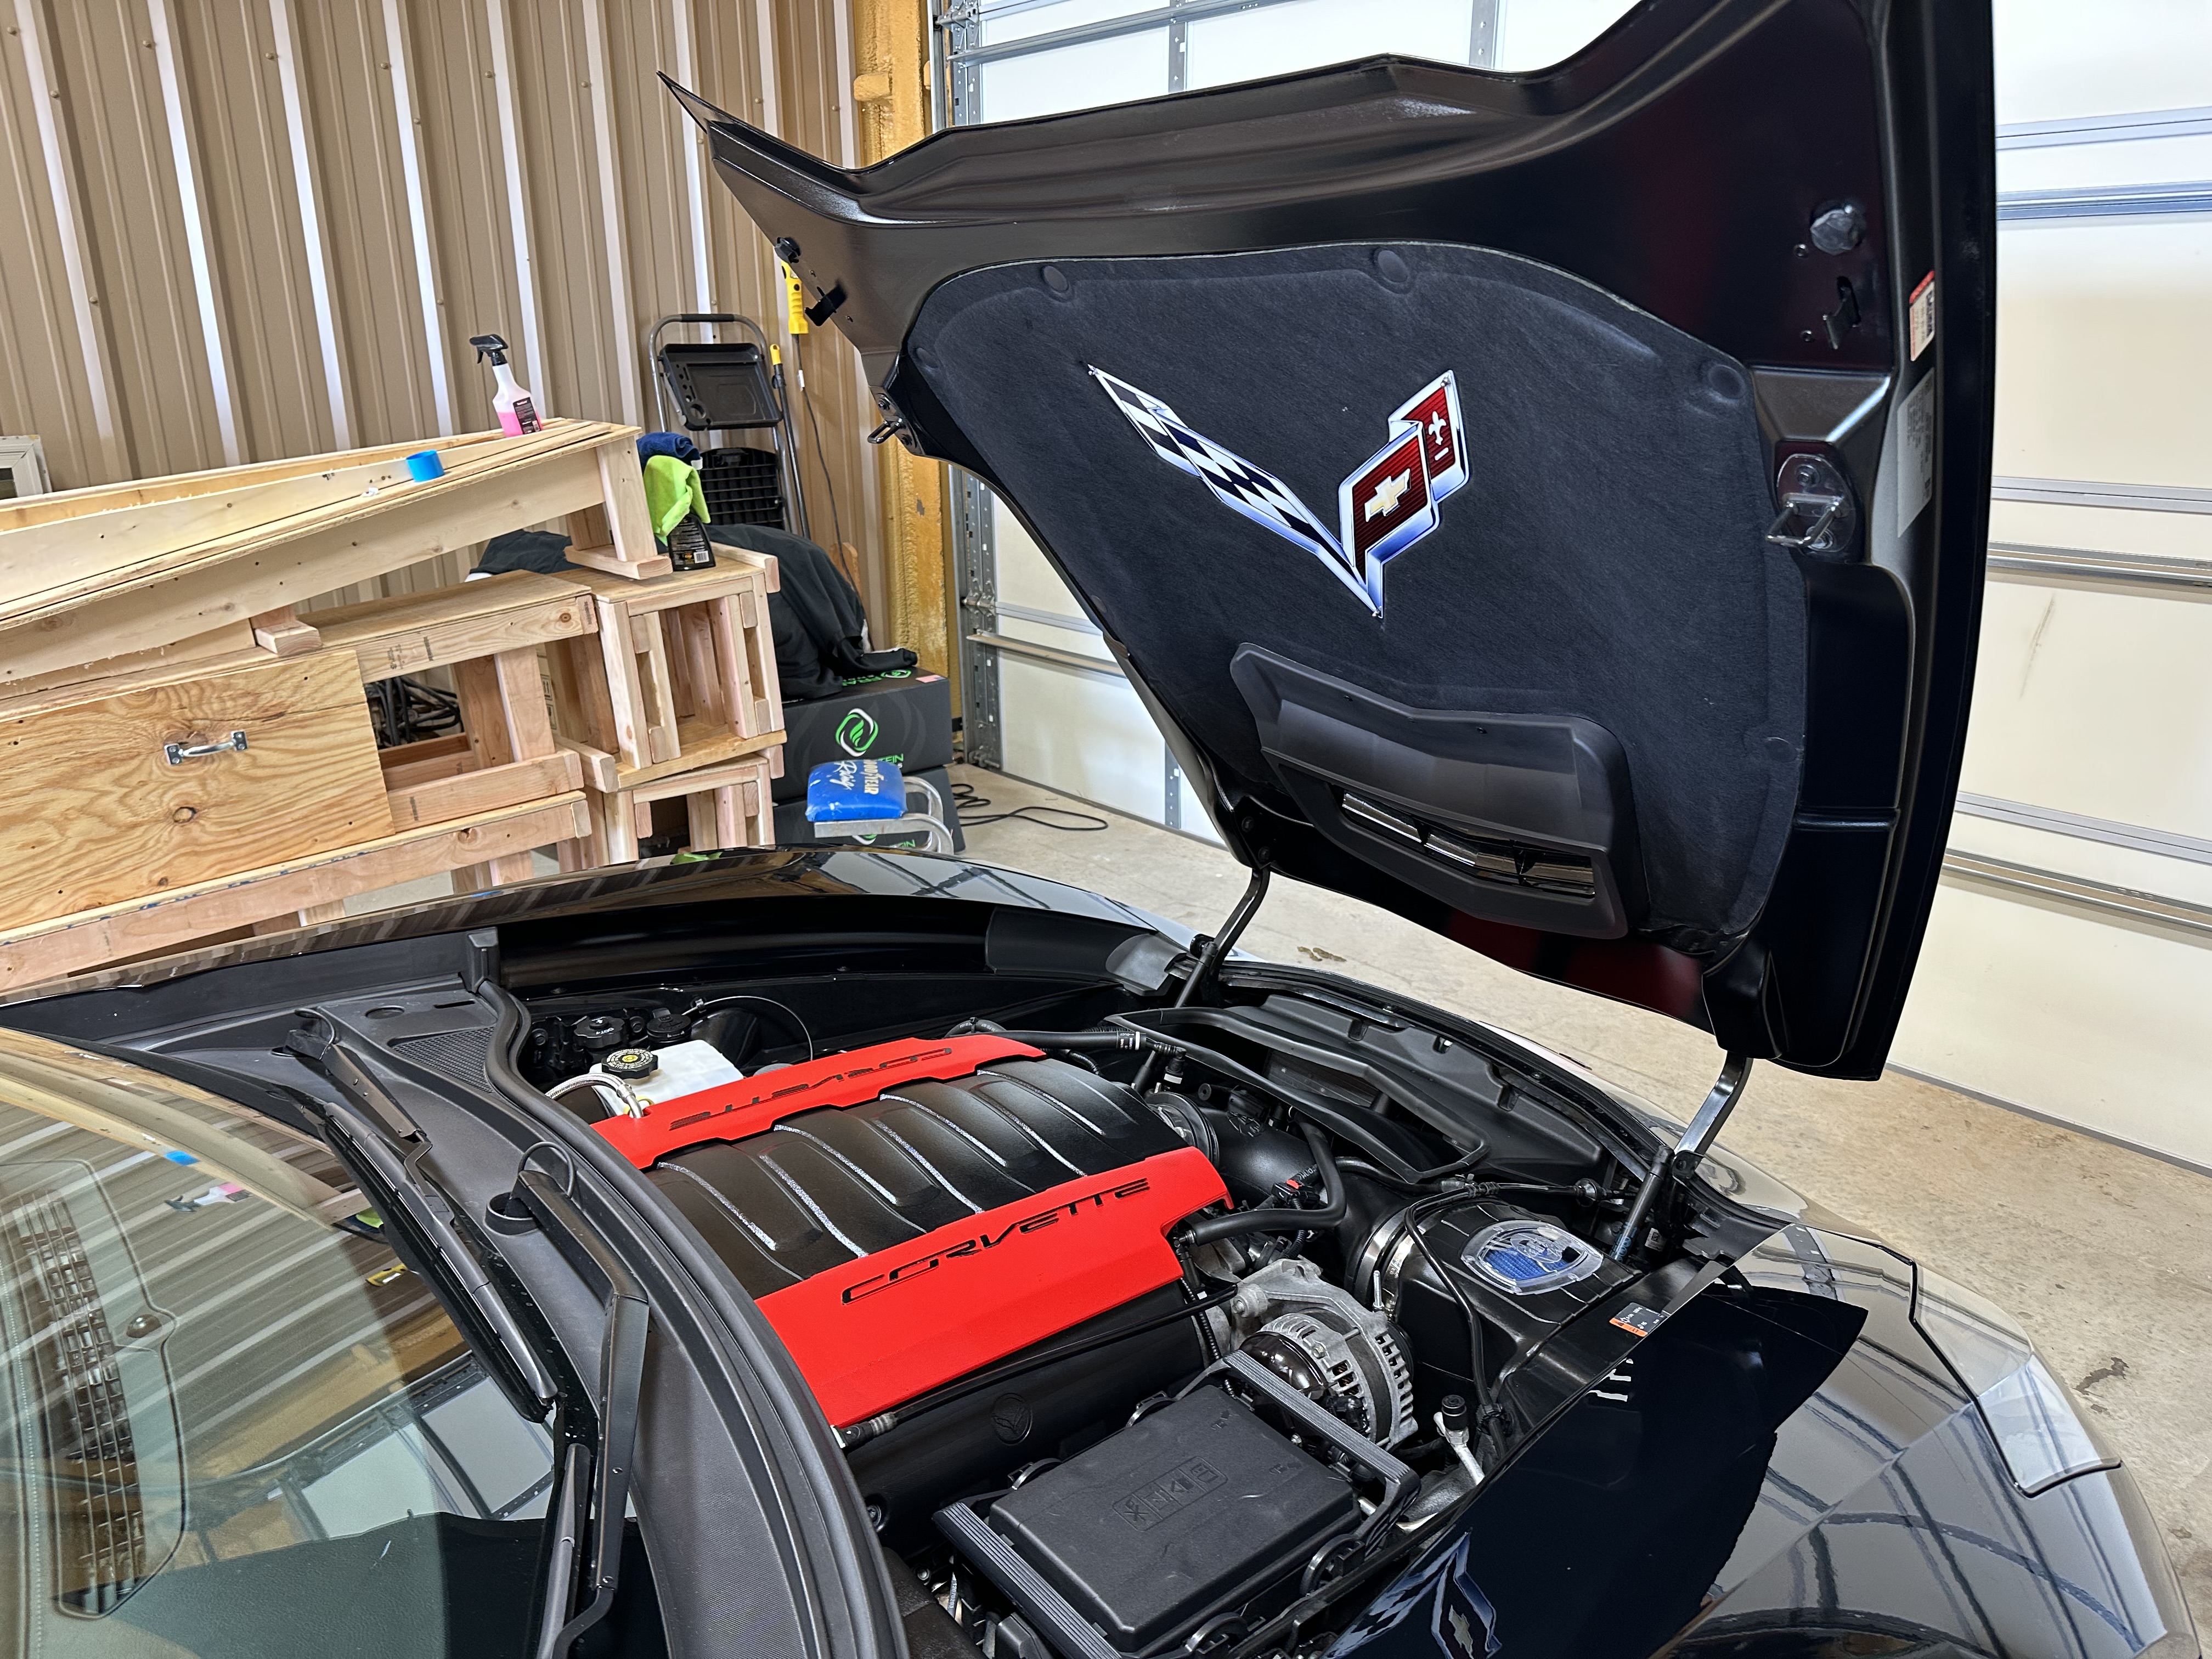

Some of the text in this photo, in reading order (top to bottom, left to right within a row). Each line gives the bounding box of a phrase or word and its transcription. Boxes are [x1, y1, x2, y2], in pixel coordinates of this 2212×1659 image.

[862, 759, 881, 794] OODYEAR
[669, 1048, 952, 1131] CORVETTE
[842, 1178, 1150, 1305] CORVETTE
